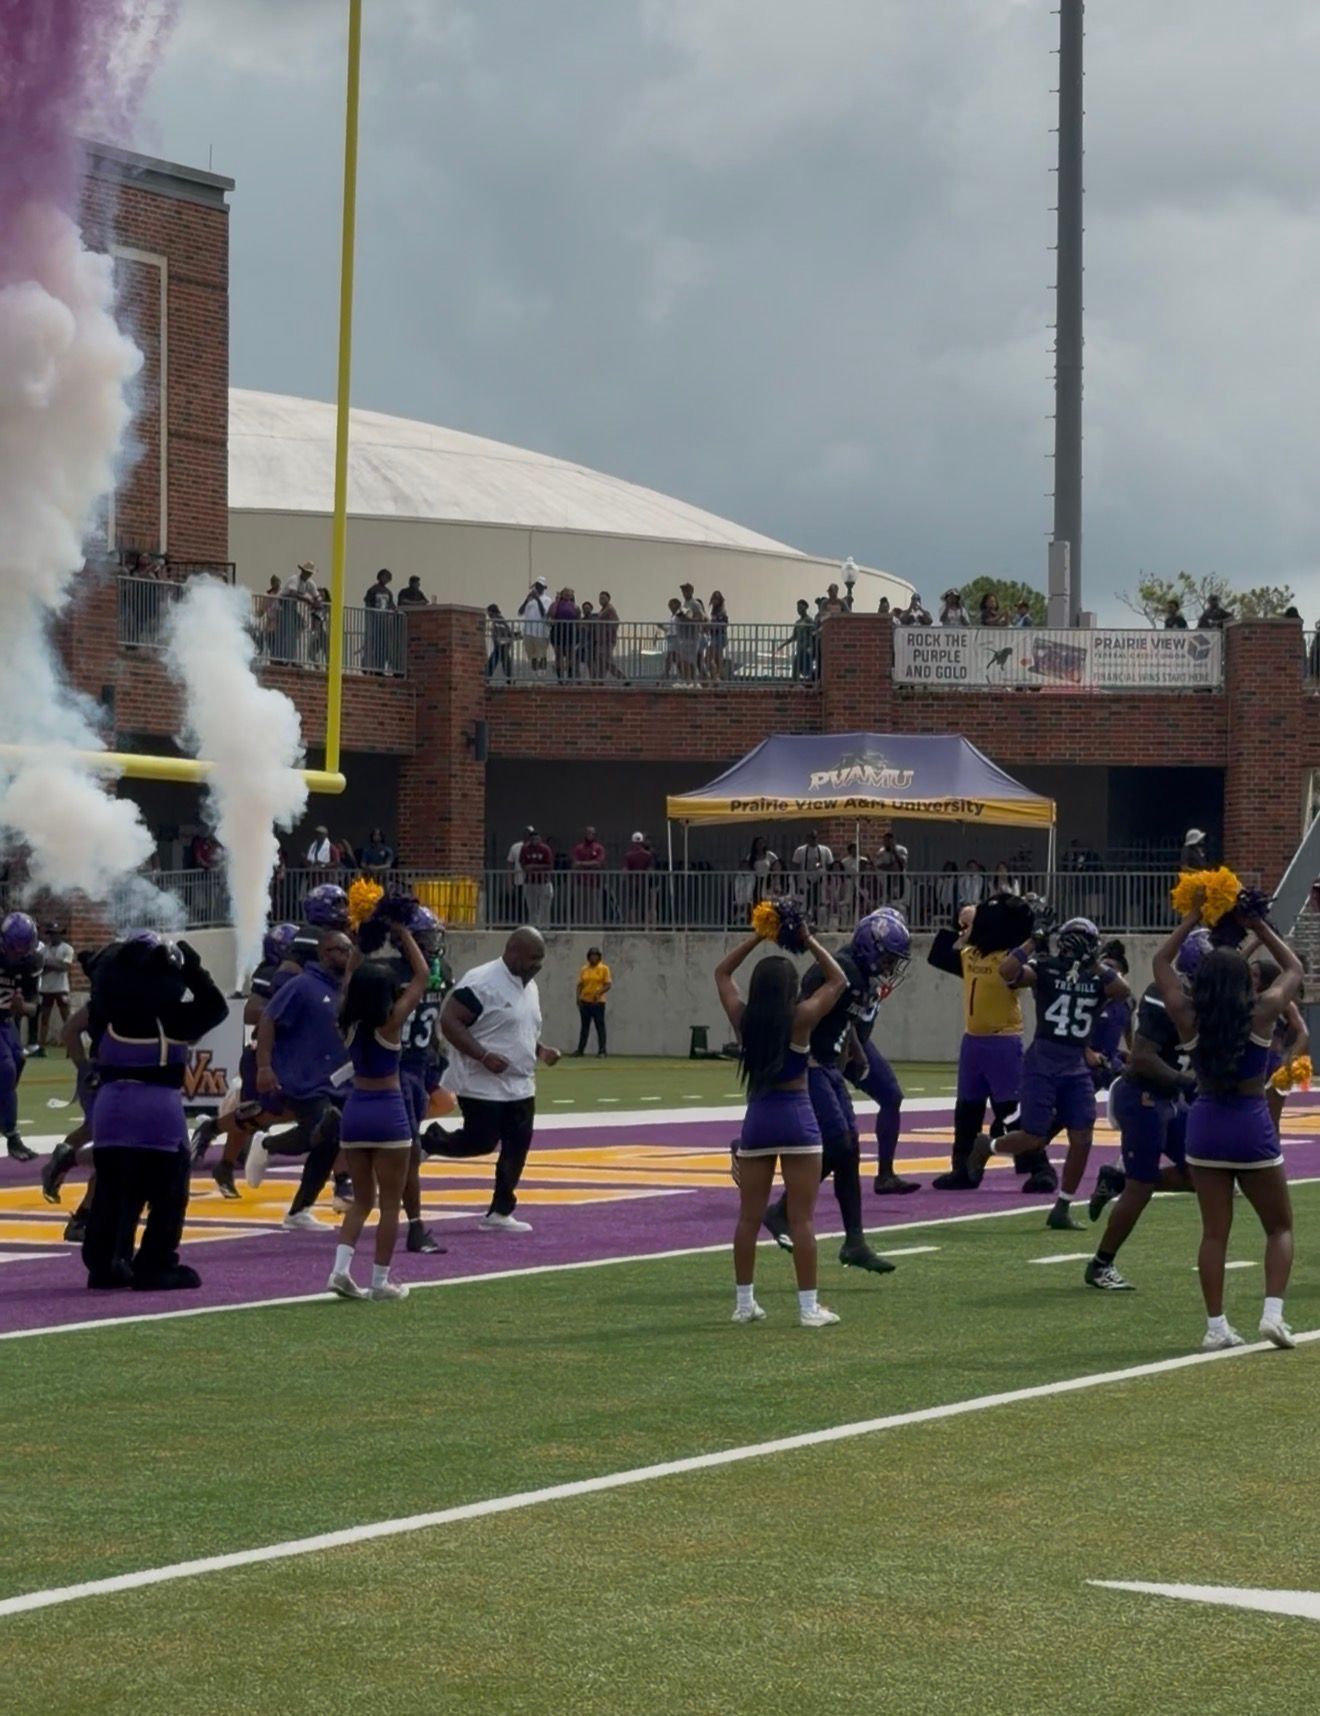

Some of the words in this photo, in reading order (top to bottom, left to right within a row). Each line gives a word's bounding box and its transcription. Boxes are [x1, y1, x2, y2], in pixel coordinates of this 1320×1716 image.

[907, 633, 941, 646] ROCK
[944, 634, 967, 647] THE
[1094, 637, 1147, 649] PRAIRIE
[1150, 637, 1186, 649] VIEW
[913, 649, 961, 663] PURPLE
[905, 665, 932, 679] AND
[935, 666, 967, 679] GOLD
[808, 765, 914, 791] PVAMU
[730, 798, 788, 812] Prairie
[795, 799, 838, 810] View
[891, 799, 985, 816] University
[1045, 994, 1099, 1038] 45
